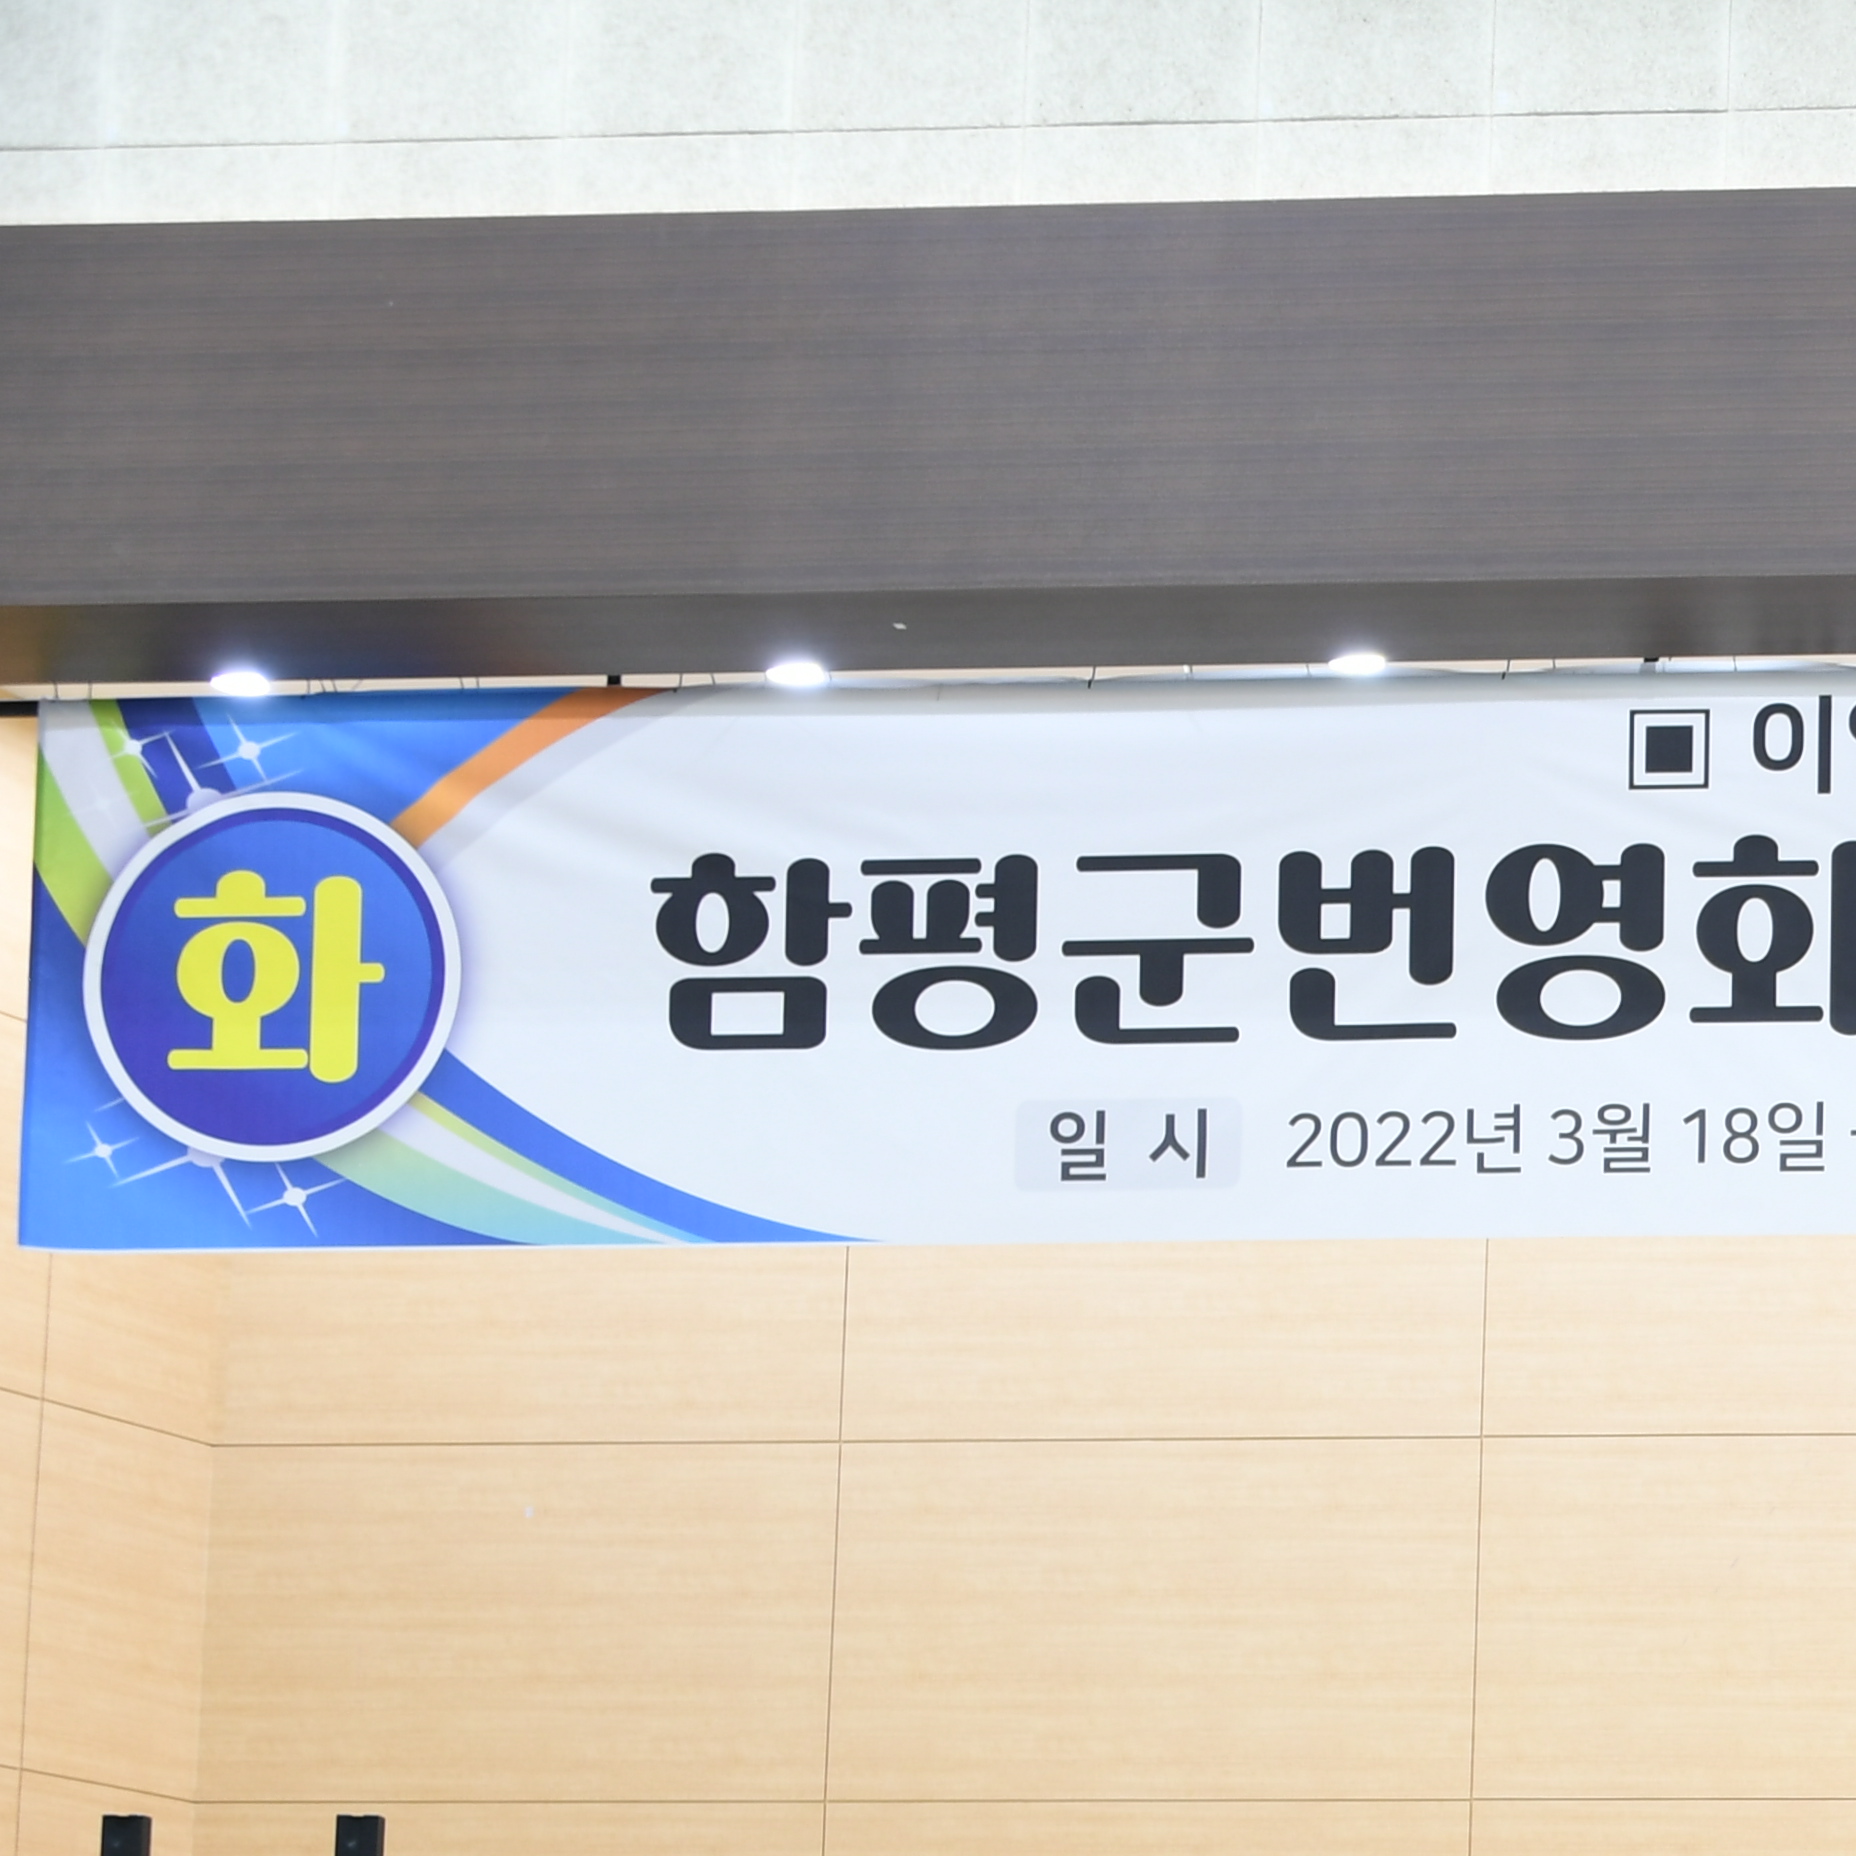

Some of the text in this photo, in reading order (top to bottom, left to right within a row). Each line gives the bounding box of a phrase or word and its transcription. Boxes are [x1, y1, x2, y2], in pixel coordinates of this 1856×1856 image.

[170, 872, 382, 1080] 화
[1287, 1104, 1523, 1175] 2022년
[1549, 1103, 1652, 1174] 3월
[1684, 1102, 1826, 1172] 18일
